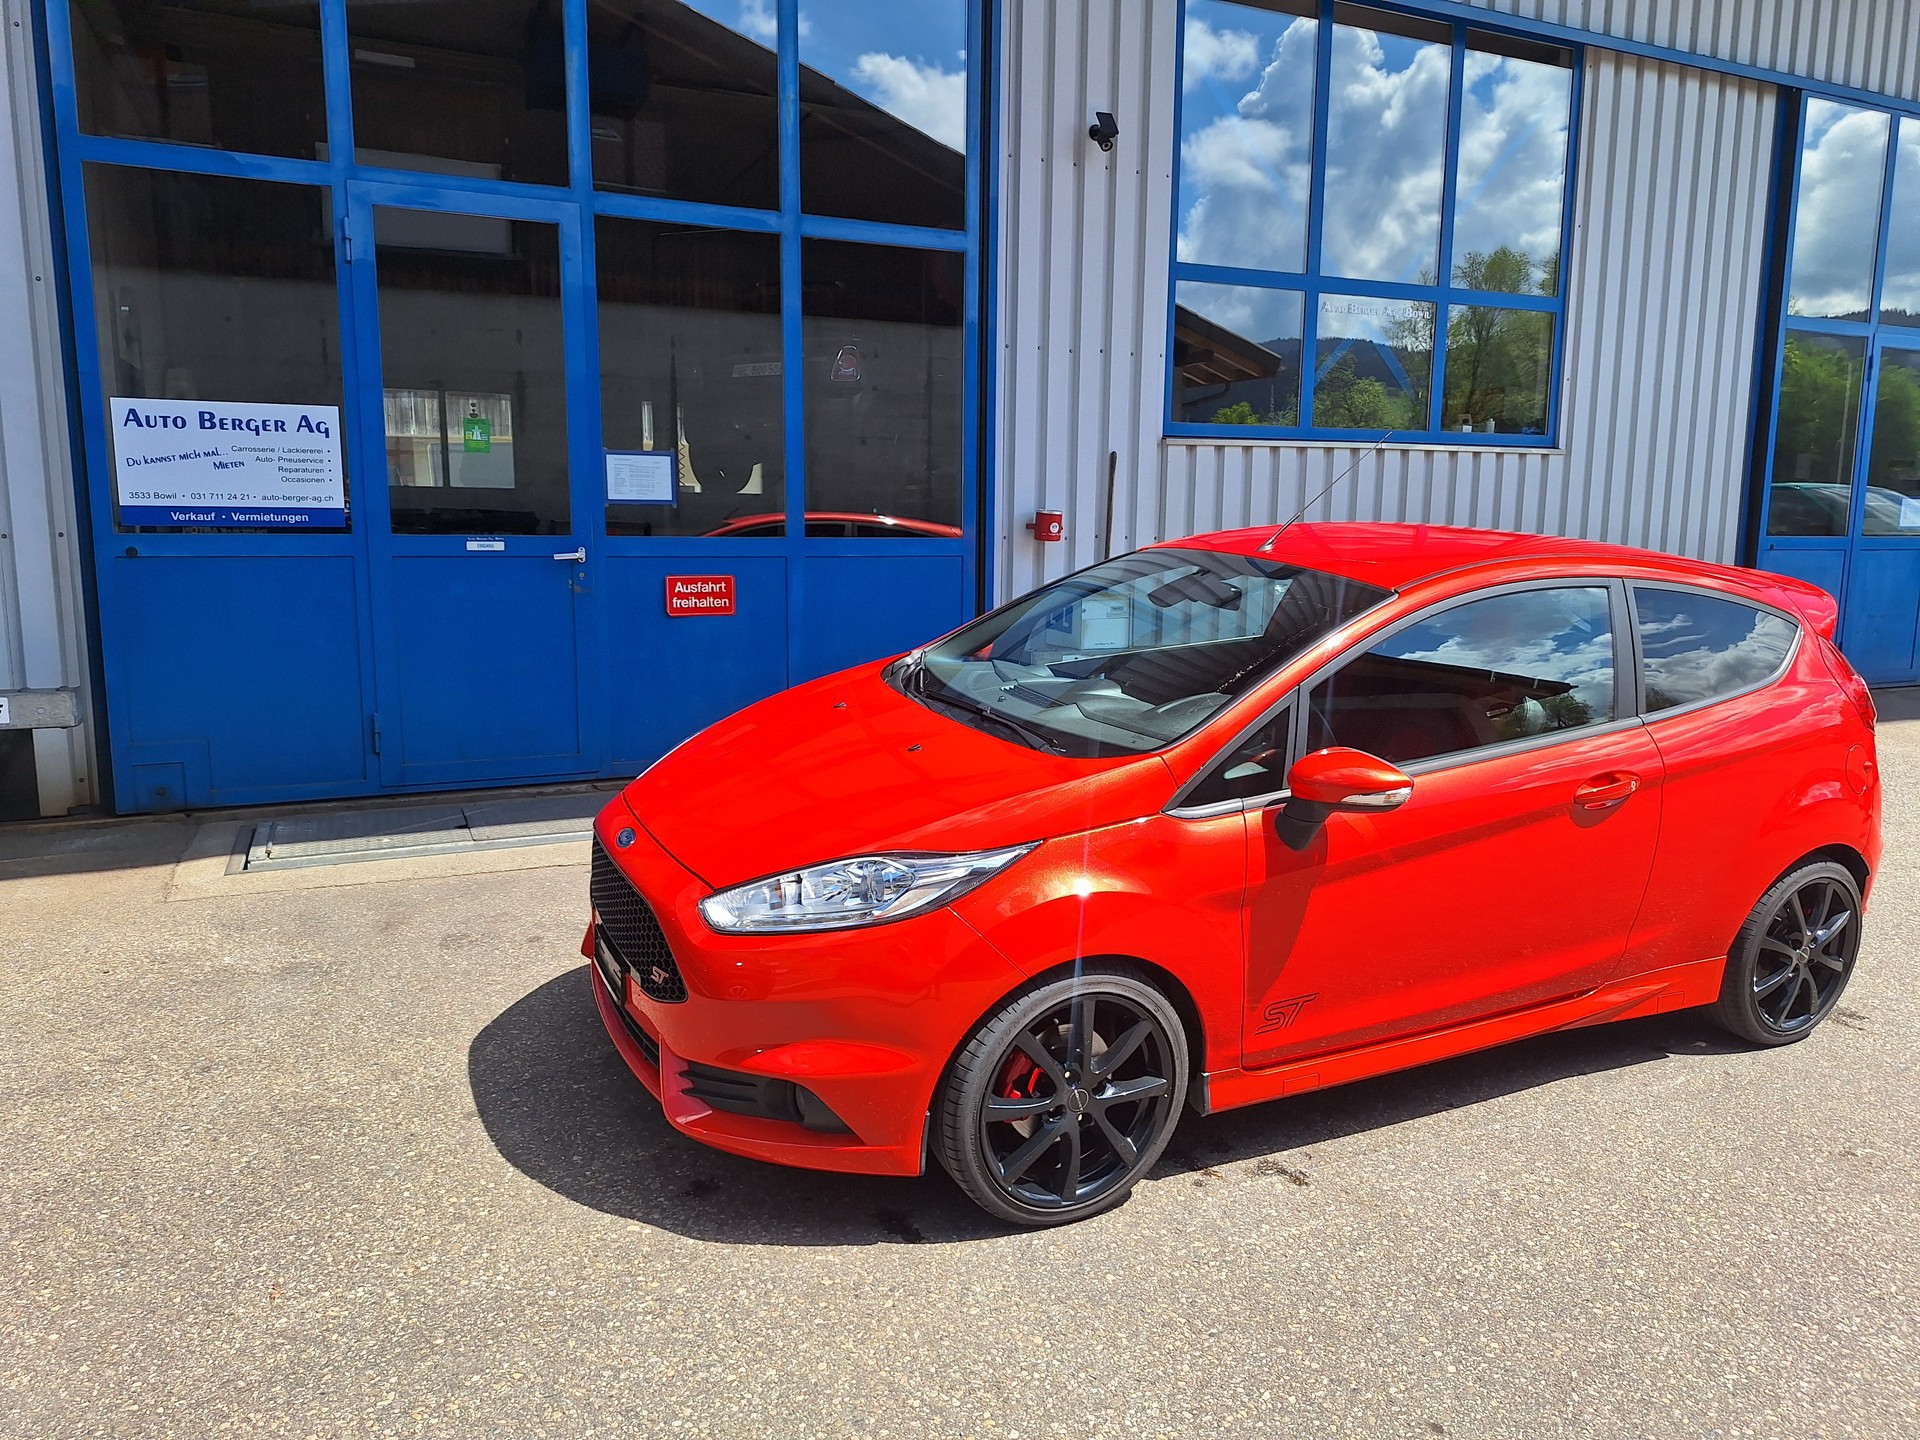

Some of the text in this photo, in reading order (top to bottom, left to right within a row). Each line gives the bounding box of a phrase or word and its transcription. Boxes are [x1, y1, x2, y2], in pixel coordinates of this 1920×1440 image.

[230, 445, 276, 454] Carrosserie
[282, 446, 324, 455] Lackiererei
[277, 456, 324, 465] Pneuservice
[278, 466, 325, 475] Reparaturen
[281, 475, 326, 484] Occasionen
[128, 491, 334, 503] 3533 Bowil 031 711 24 21 auto-berger-ag.ch
[170, 511, 309, 524] Verkauf Vermietungen
[674, 581, 727, 593] Ausfahrt
[672, 596, 730, 608] freihalten
[650, 965, 670, 984] ST
[1254, 991, 1320, 1036] ST
